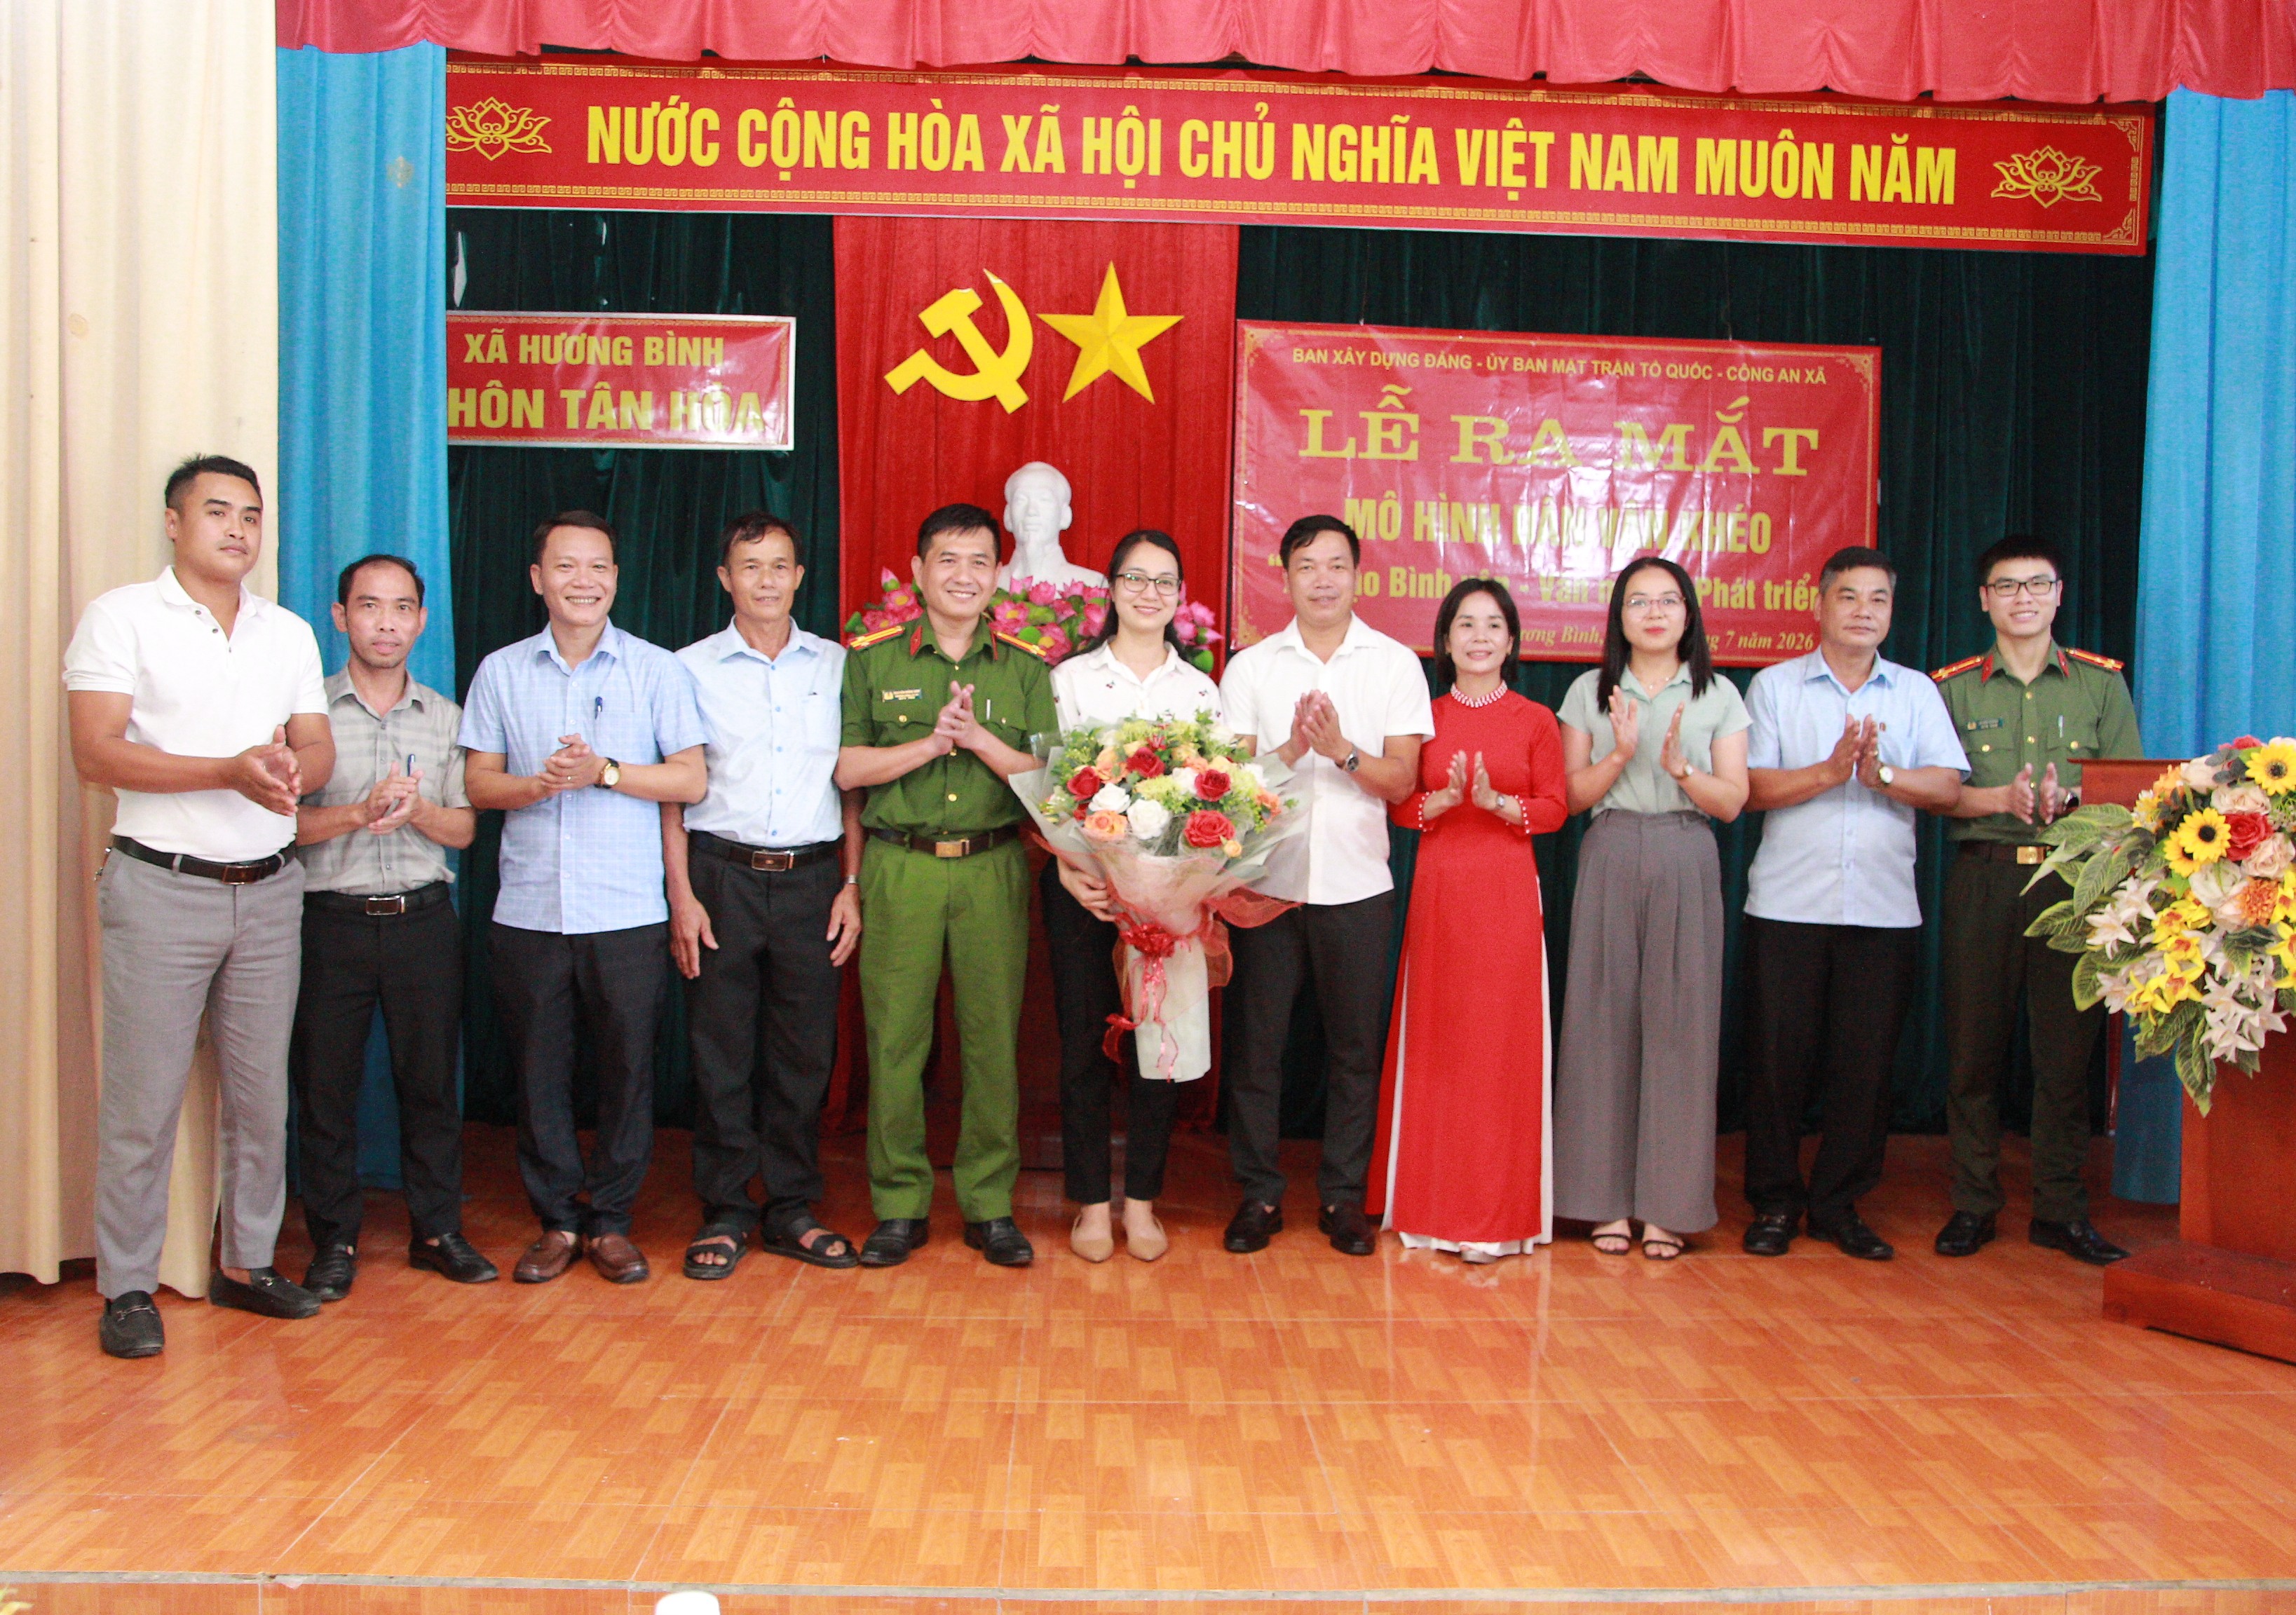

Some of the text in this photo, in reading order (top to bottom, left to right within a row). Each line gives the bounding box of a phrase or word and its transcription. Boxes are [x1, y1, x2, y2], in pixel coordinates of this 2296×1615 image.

[587, 96, 1956, 205] NƯỚC CỘNG HÒA XÃ HỘI CHỦ NGHĨA VIỆT NAM MUÔN NĂM
[464, 328, 724, 367] XÃ HƯƠNG BÌNH
[1293, 348, 1328, 363] BAN
[1333, 346, 1366, 365] XÂY
[1371, 351, 1420, 370] DỰNG
[1486, 353, 1509, 371] ỦY
[1513, 357, 1547, 372] BAN
[1727, 362, 1774, 382] CÔNG
[1777, 367, 1800, 383] AN
[1805, 366, 1826, 384] XÃ
[448, 380, 766, 432] HÔN TÂN HÒA
[1298, 384, 1819, 475] LỄ RA MẮT
[1344, 490, 1401, 540] MÔ
[1413, 493, 1500, 545] HÌNH
[1682, 503, 1772, 554] KHÉO
[1389, 566, 1451, 598] Bình
[1695, 577, 1756, 610] Phát
[1725, 630, 1735, 648] 7
[1738, 632, 1772, 649] năm
[1777, 632, 1814, 651] 2026
